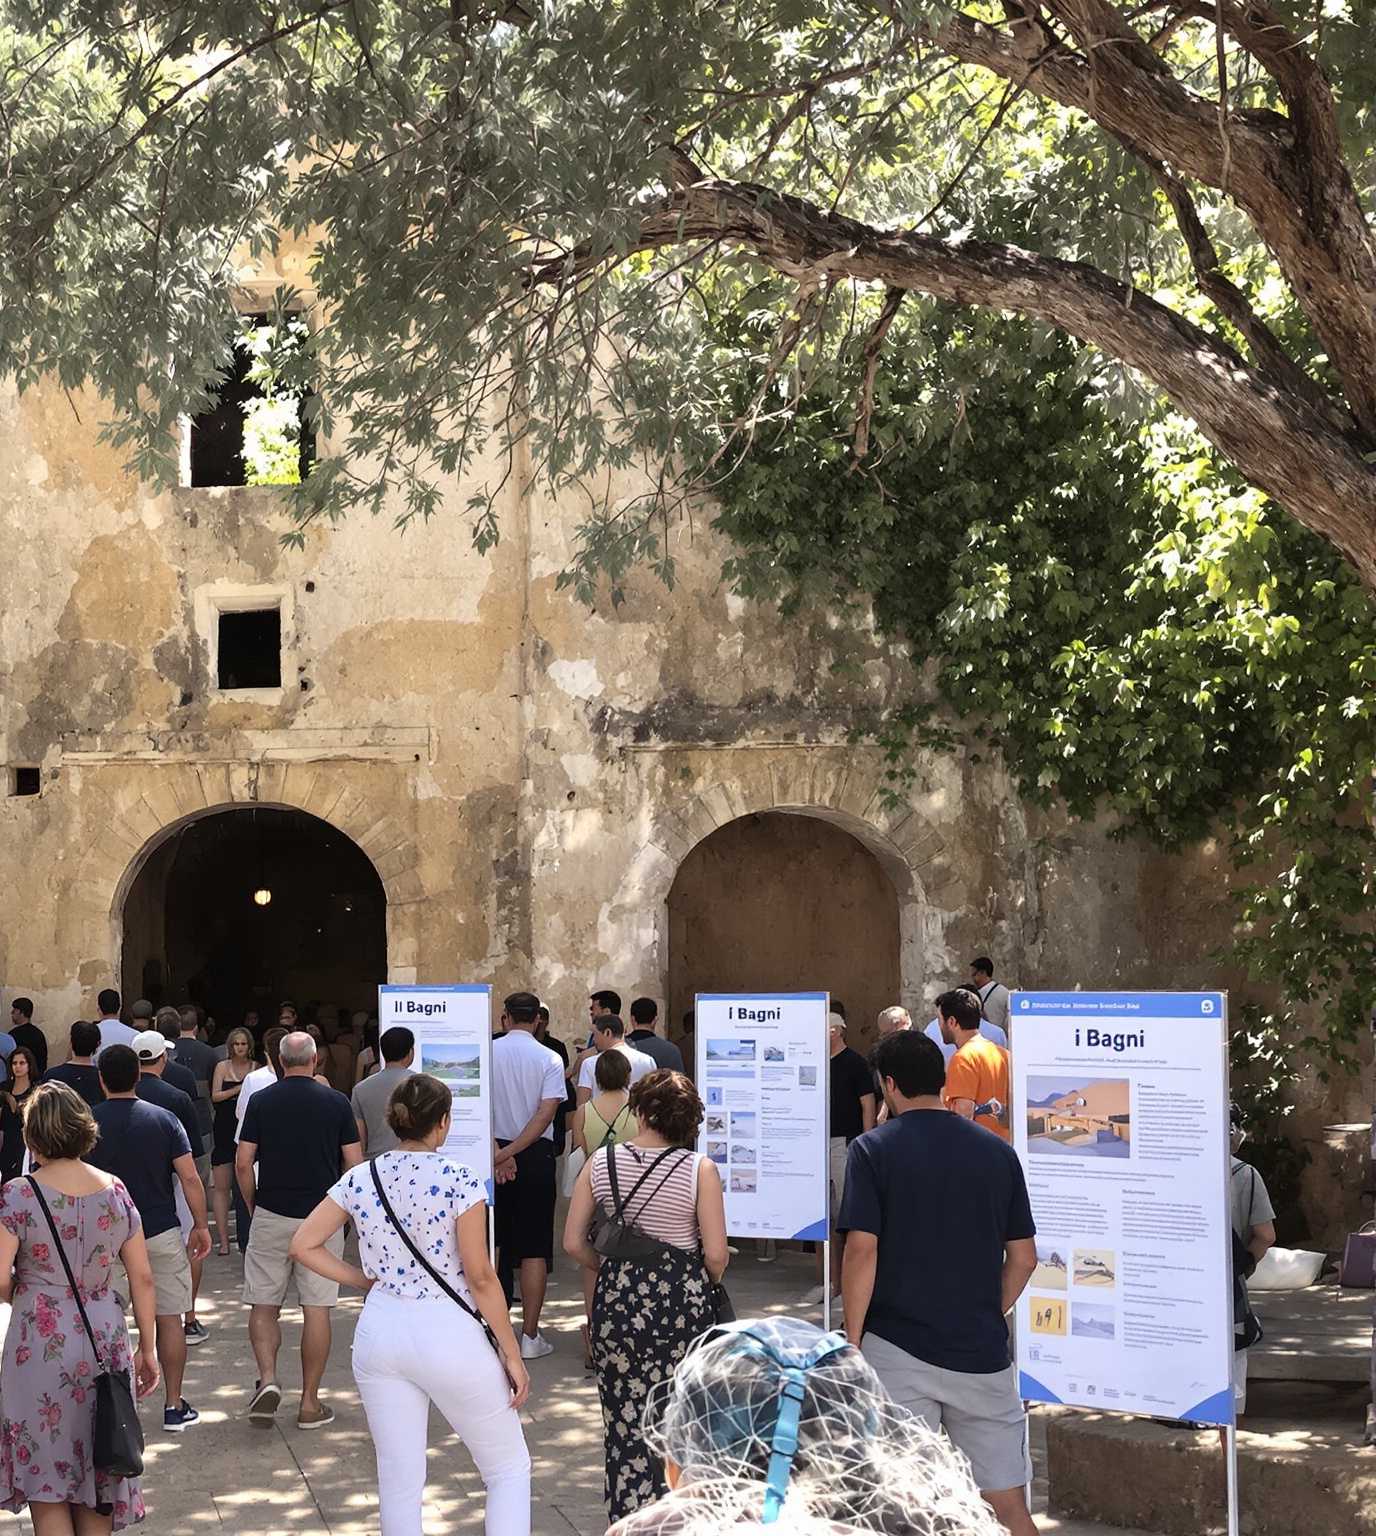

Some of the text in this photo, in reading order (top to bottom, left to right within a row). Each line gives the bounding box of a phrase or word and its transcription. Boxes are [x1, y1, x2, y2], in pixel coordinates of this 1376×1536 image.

[407, 1001, 446, 1016] Bagni
[738, 1007, 781, 1023] Bagni
[1075, 1028, 1144, 1052] i Bagni
